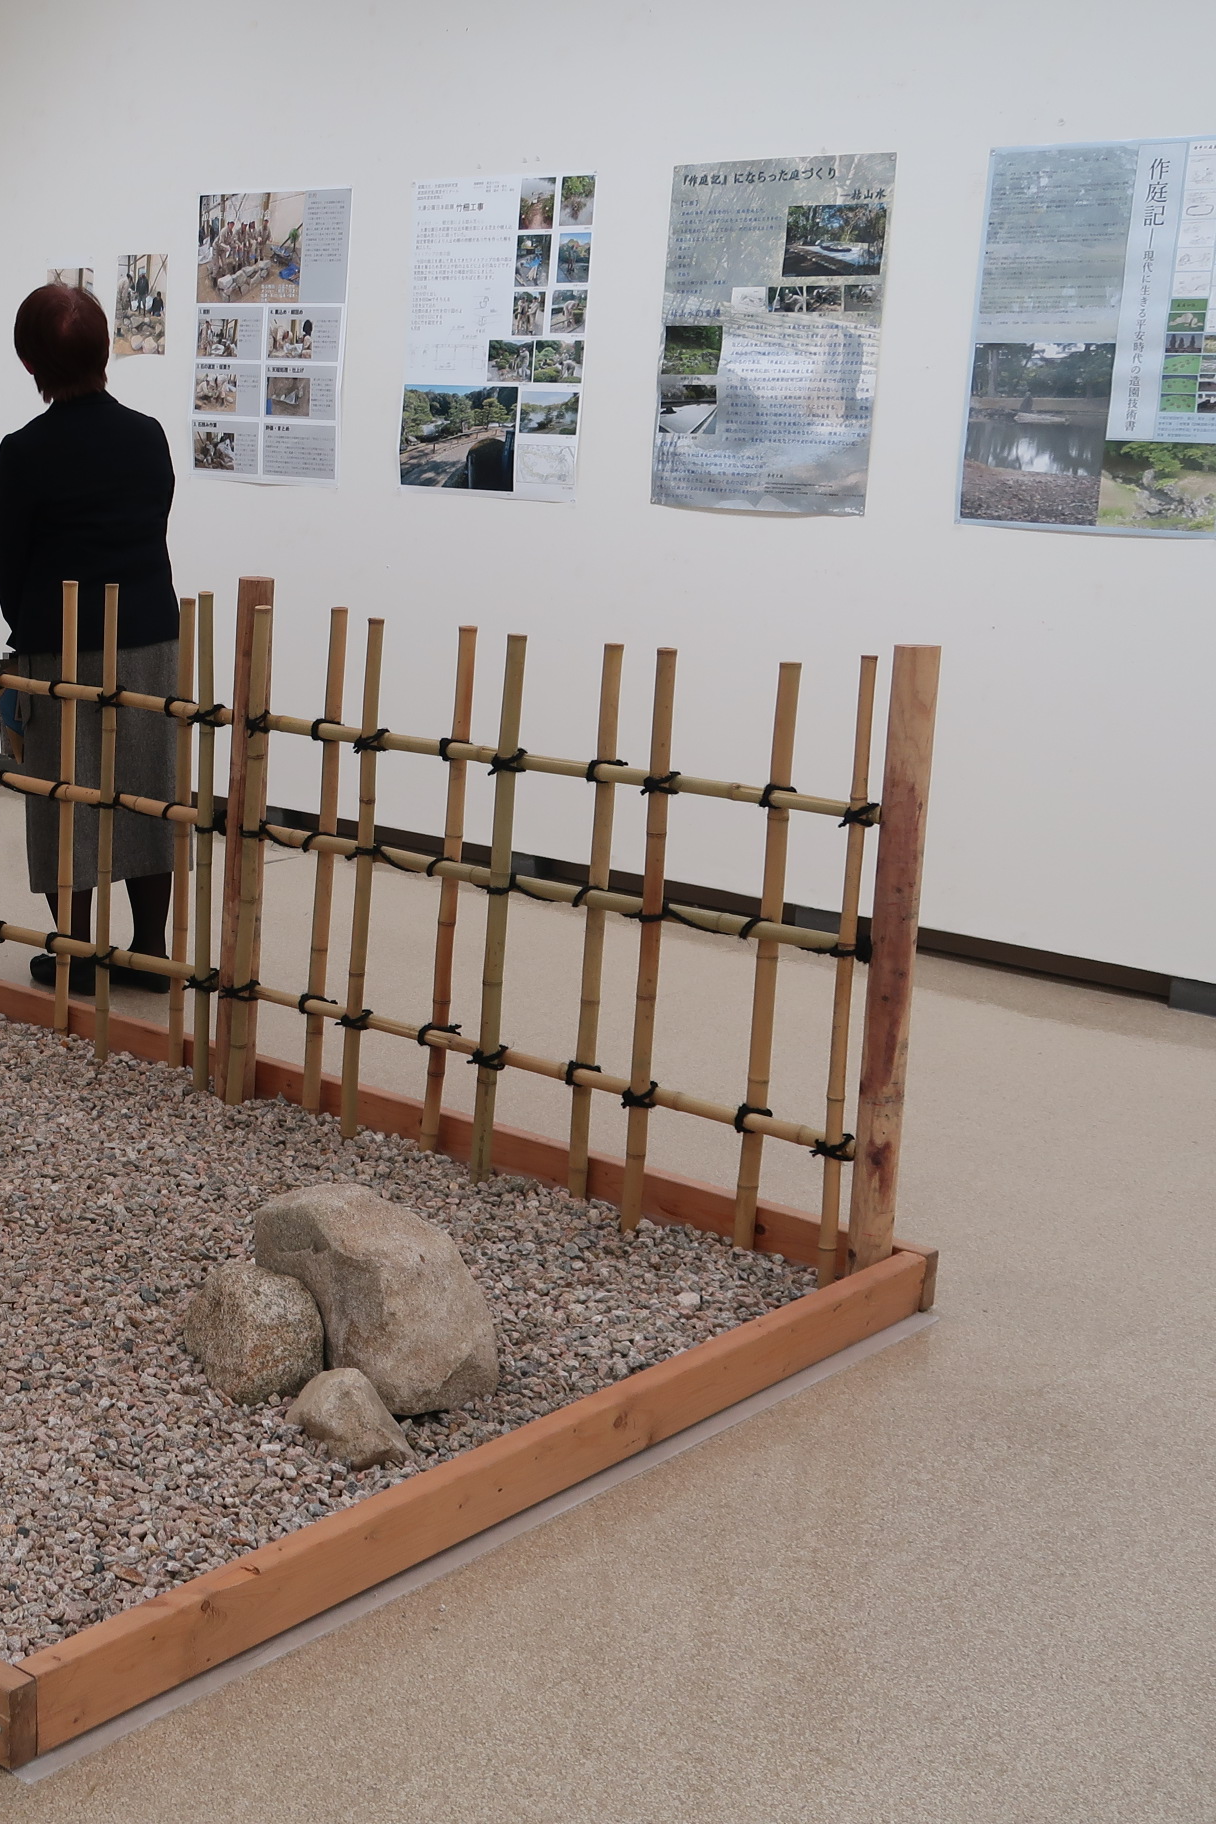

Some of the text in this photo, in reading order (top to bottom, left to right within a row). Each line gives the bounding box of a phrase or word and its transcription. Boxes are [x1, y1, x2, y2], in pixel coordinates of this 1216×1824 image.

[681, 166, 837, 187] 『作庭記』にならった庭づくり
